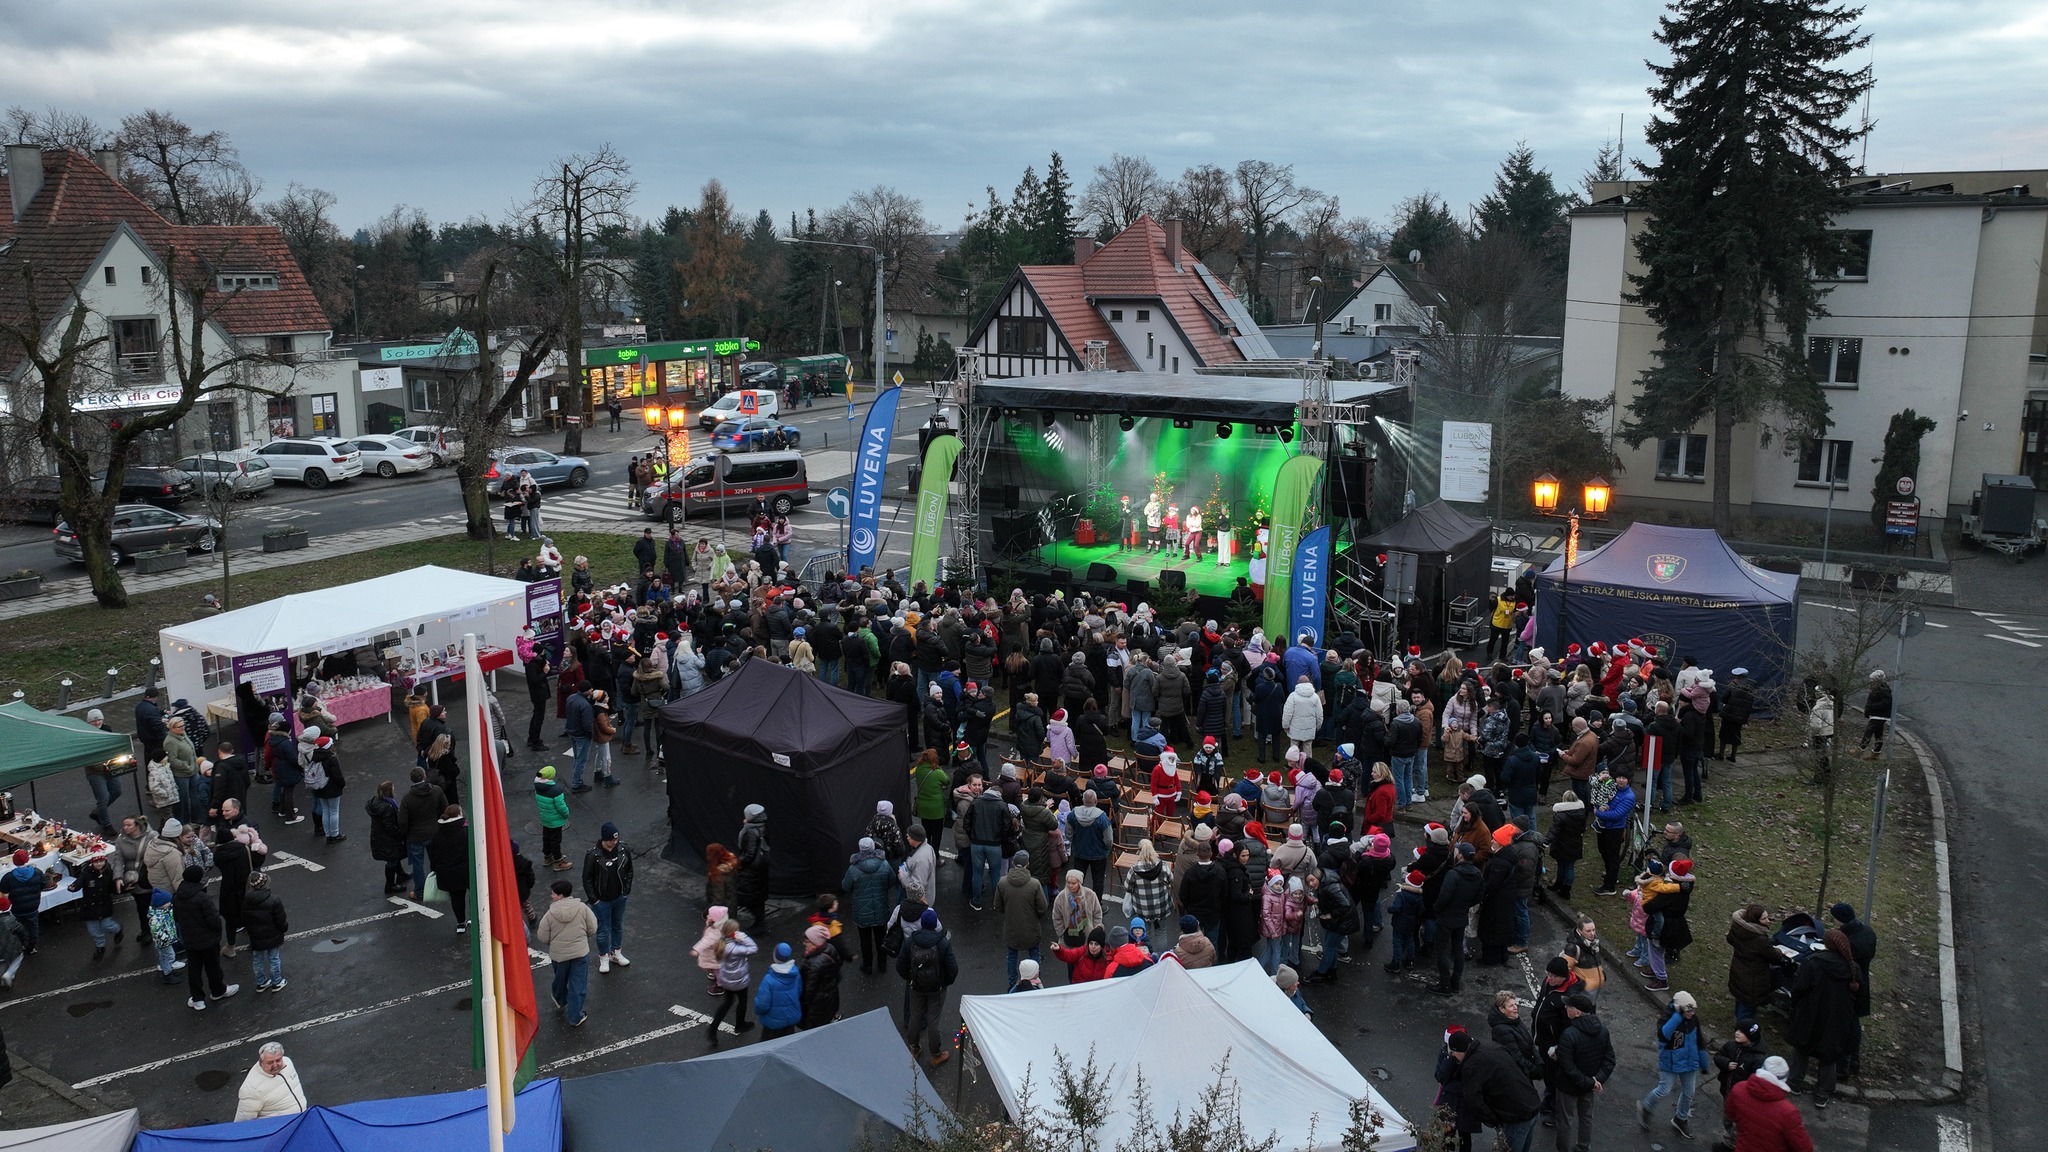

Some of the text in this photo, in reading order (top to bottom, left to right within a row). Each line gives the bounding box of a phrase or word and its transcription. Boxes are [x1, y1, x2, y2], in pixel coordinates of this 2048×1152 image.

[618, 349, 638, 358] żabka
[715, 341, 739, 352] żabka
[127, 391, 151, 402] dla
[156, 389, 184, 400] Cie
[858, 427, 886, 519] LUVENA
[926, 495, 939, 533] LUBOŃ
[1280, 529, 1294, 574] LUBOŃ
[1301, 545, 1318, 619] LUVENA
[1581, 585, 1614, 597] STRAŻ
[1616, 589, 1660, 602] MIEJSKA
[1662, 595, 1700, 607] MIASTA
